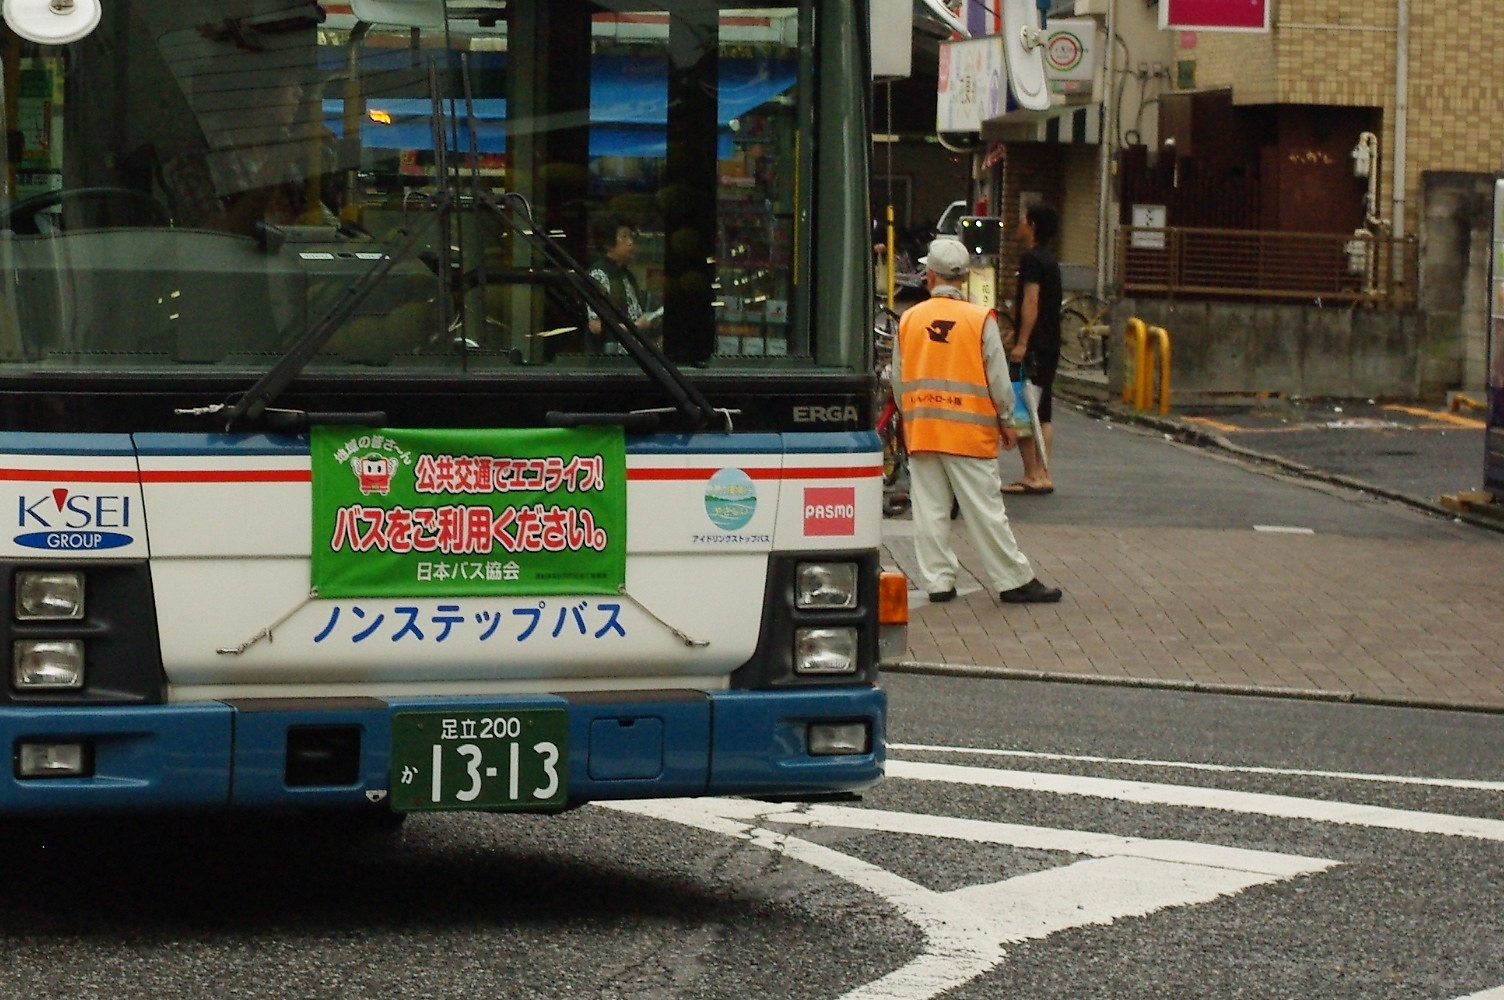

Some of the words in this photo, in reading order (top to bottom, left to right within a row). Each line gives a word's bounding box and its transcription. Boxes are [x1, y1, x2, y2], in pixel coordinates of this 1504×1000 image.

[792, 405, 859, 423] ERGA
[804, 503, 855, 520] PASMO
[331, 503, 609, 554] バスをご利用ください。
[46, 532, 104, 550] GROUP
[416, 560, 521, 582] 日本バス協会
[313, 600, 627, 644] ノンステップバス
[400, 764, 419, 785] か
[430, 741, 560, 803] 13-13
